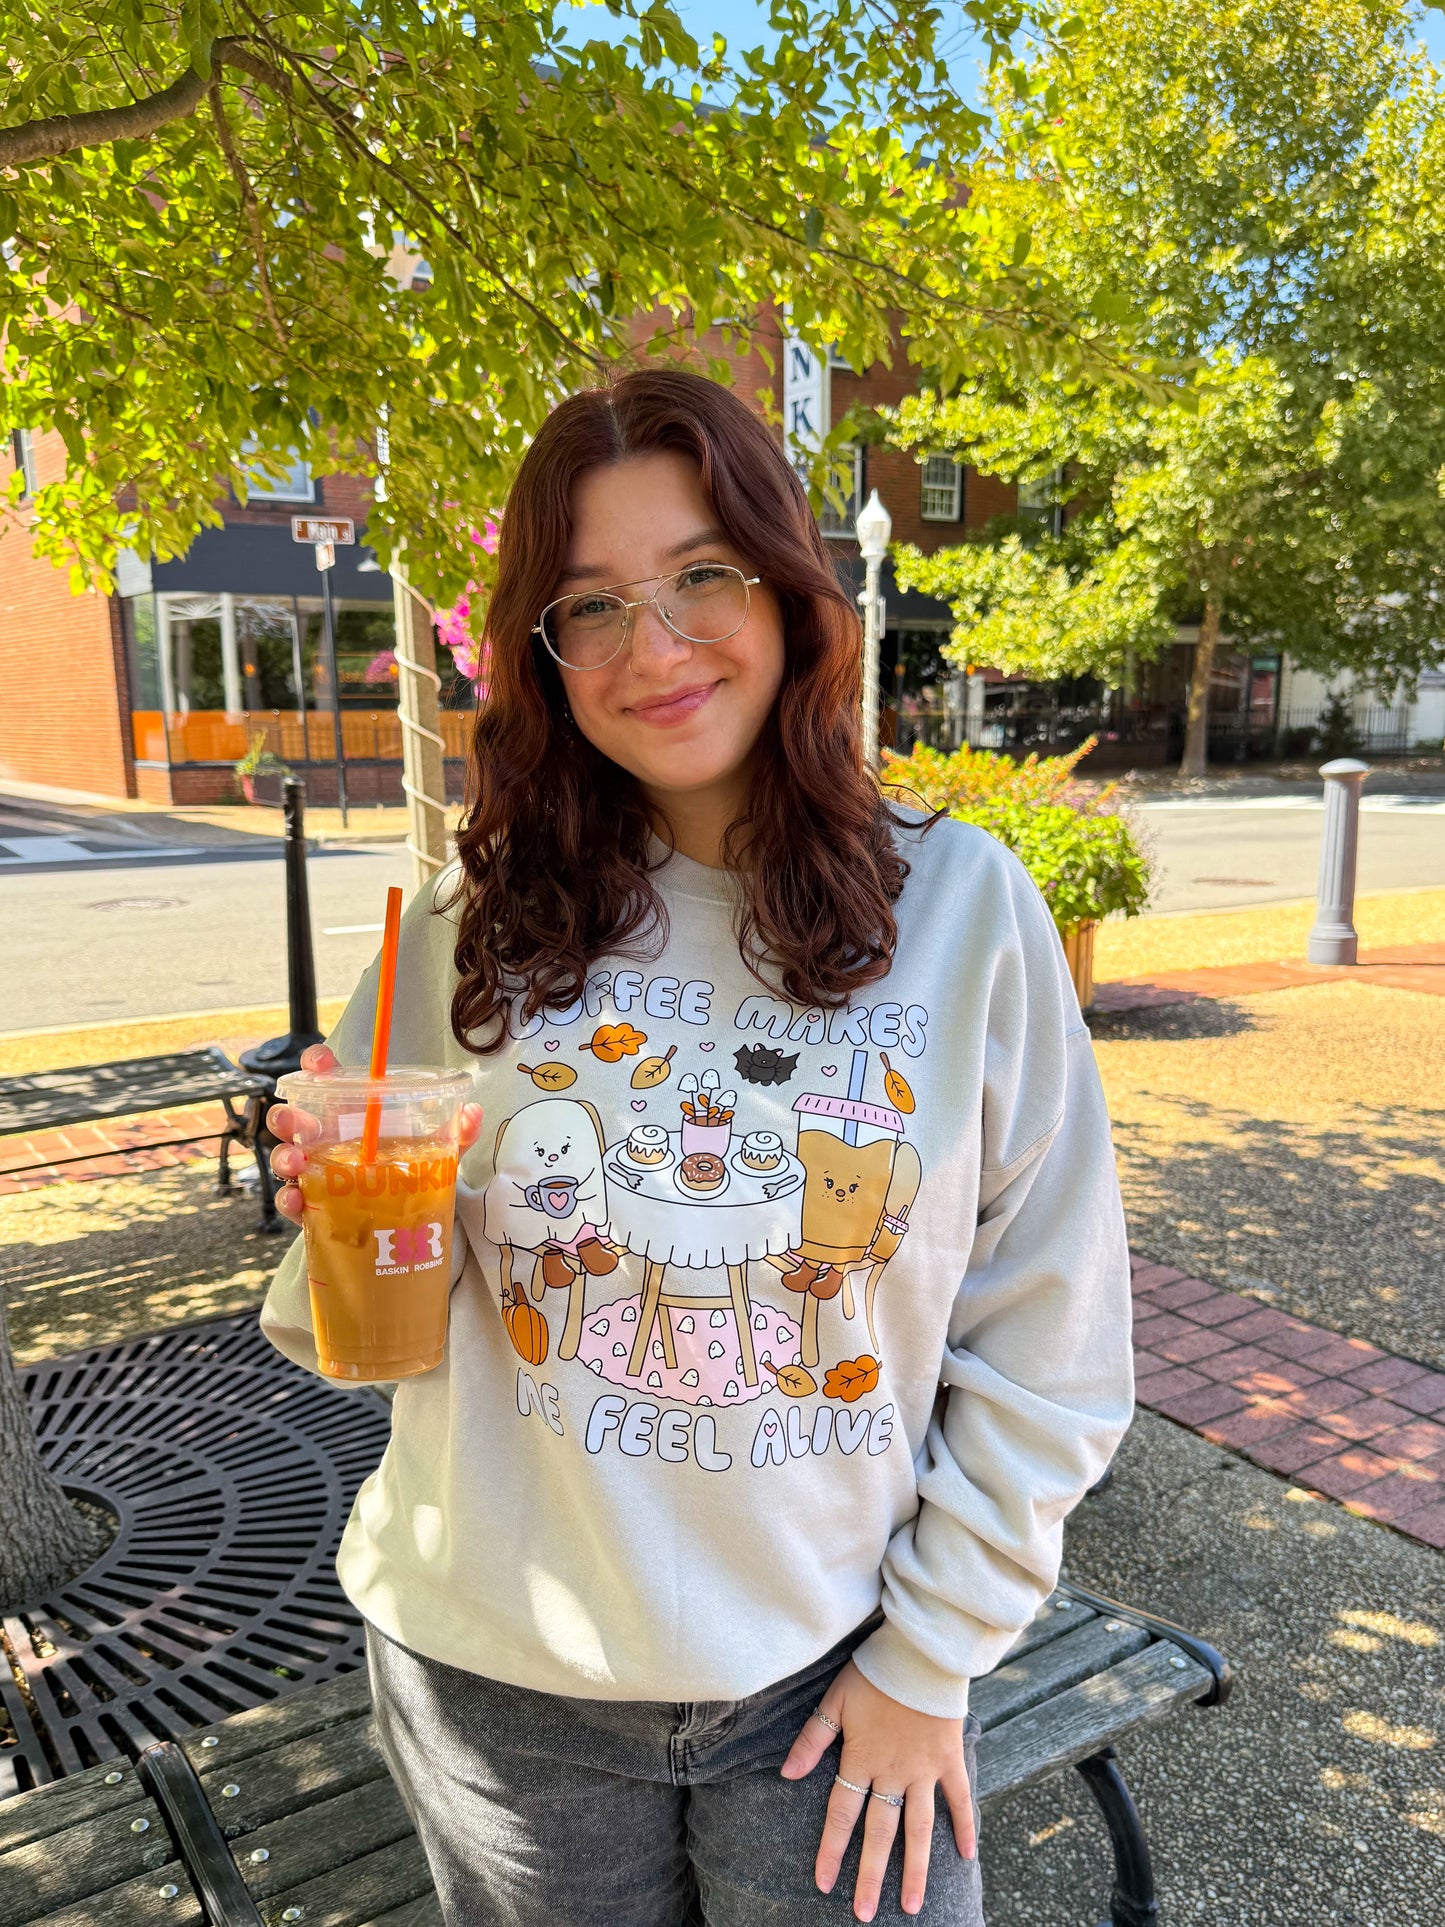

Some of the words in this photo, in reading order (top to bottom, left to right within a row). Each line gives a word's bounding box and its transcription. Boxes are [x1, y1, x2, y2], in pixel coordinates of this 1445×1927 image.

[733, 995, 929, 1058] MAKES
[375, 1266, 409, 1276] BASKIN
[414, 1258, 443, 1272] ROBBINS
[585, 1395, 732, 1472] FEEL
[750, 1404, 895, 1468] ALIVE
